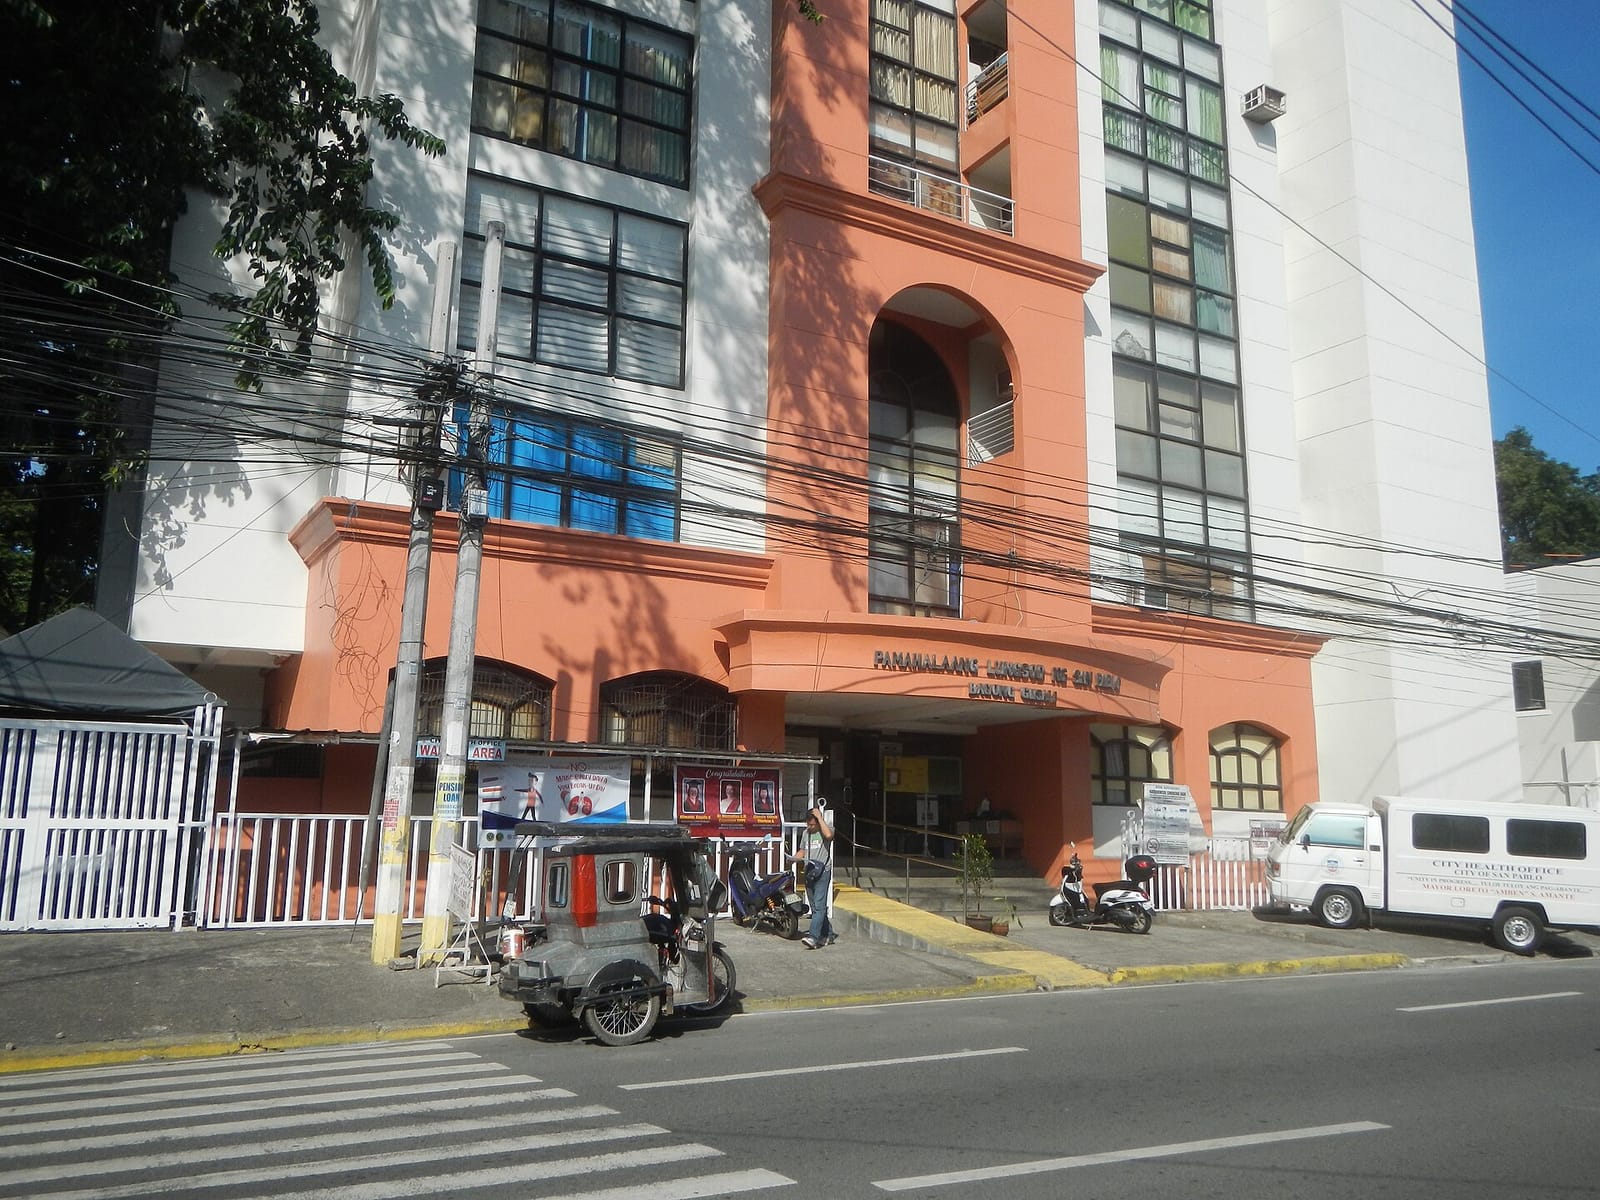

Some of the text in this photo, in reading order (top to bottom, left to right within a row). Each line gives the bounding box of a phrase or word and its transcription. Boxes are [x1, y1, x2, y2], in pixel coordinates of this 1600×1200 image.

[874, 650, 978, 675] PAMAHALAANG
[986, 660, 1045, 683] LUNGSOD
[1052, 666, 1069, 687] NG
[472, 747, 502, 759] AREA
[1432, 860, 1563, 875] CITY HEALTH OFFICE
[1512, 873, 1543, 881] PABLO
[1422, 883, 1452, 891] MAYOR
[1540, 891, 1575, 900] AMANTE
